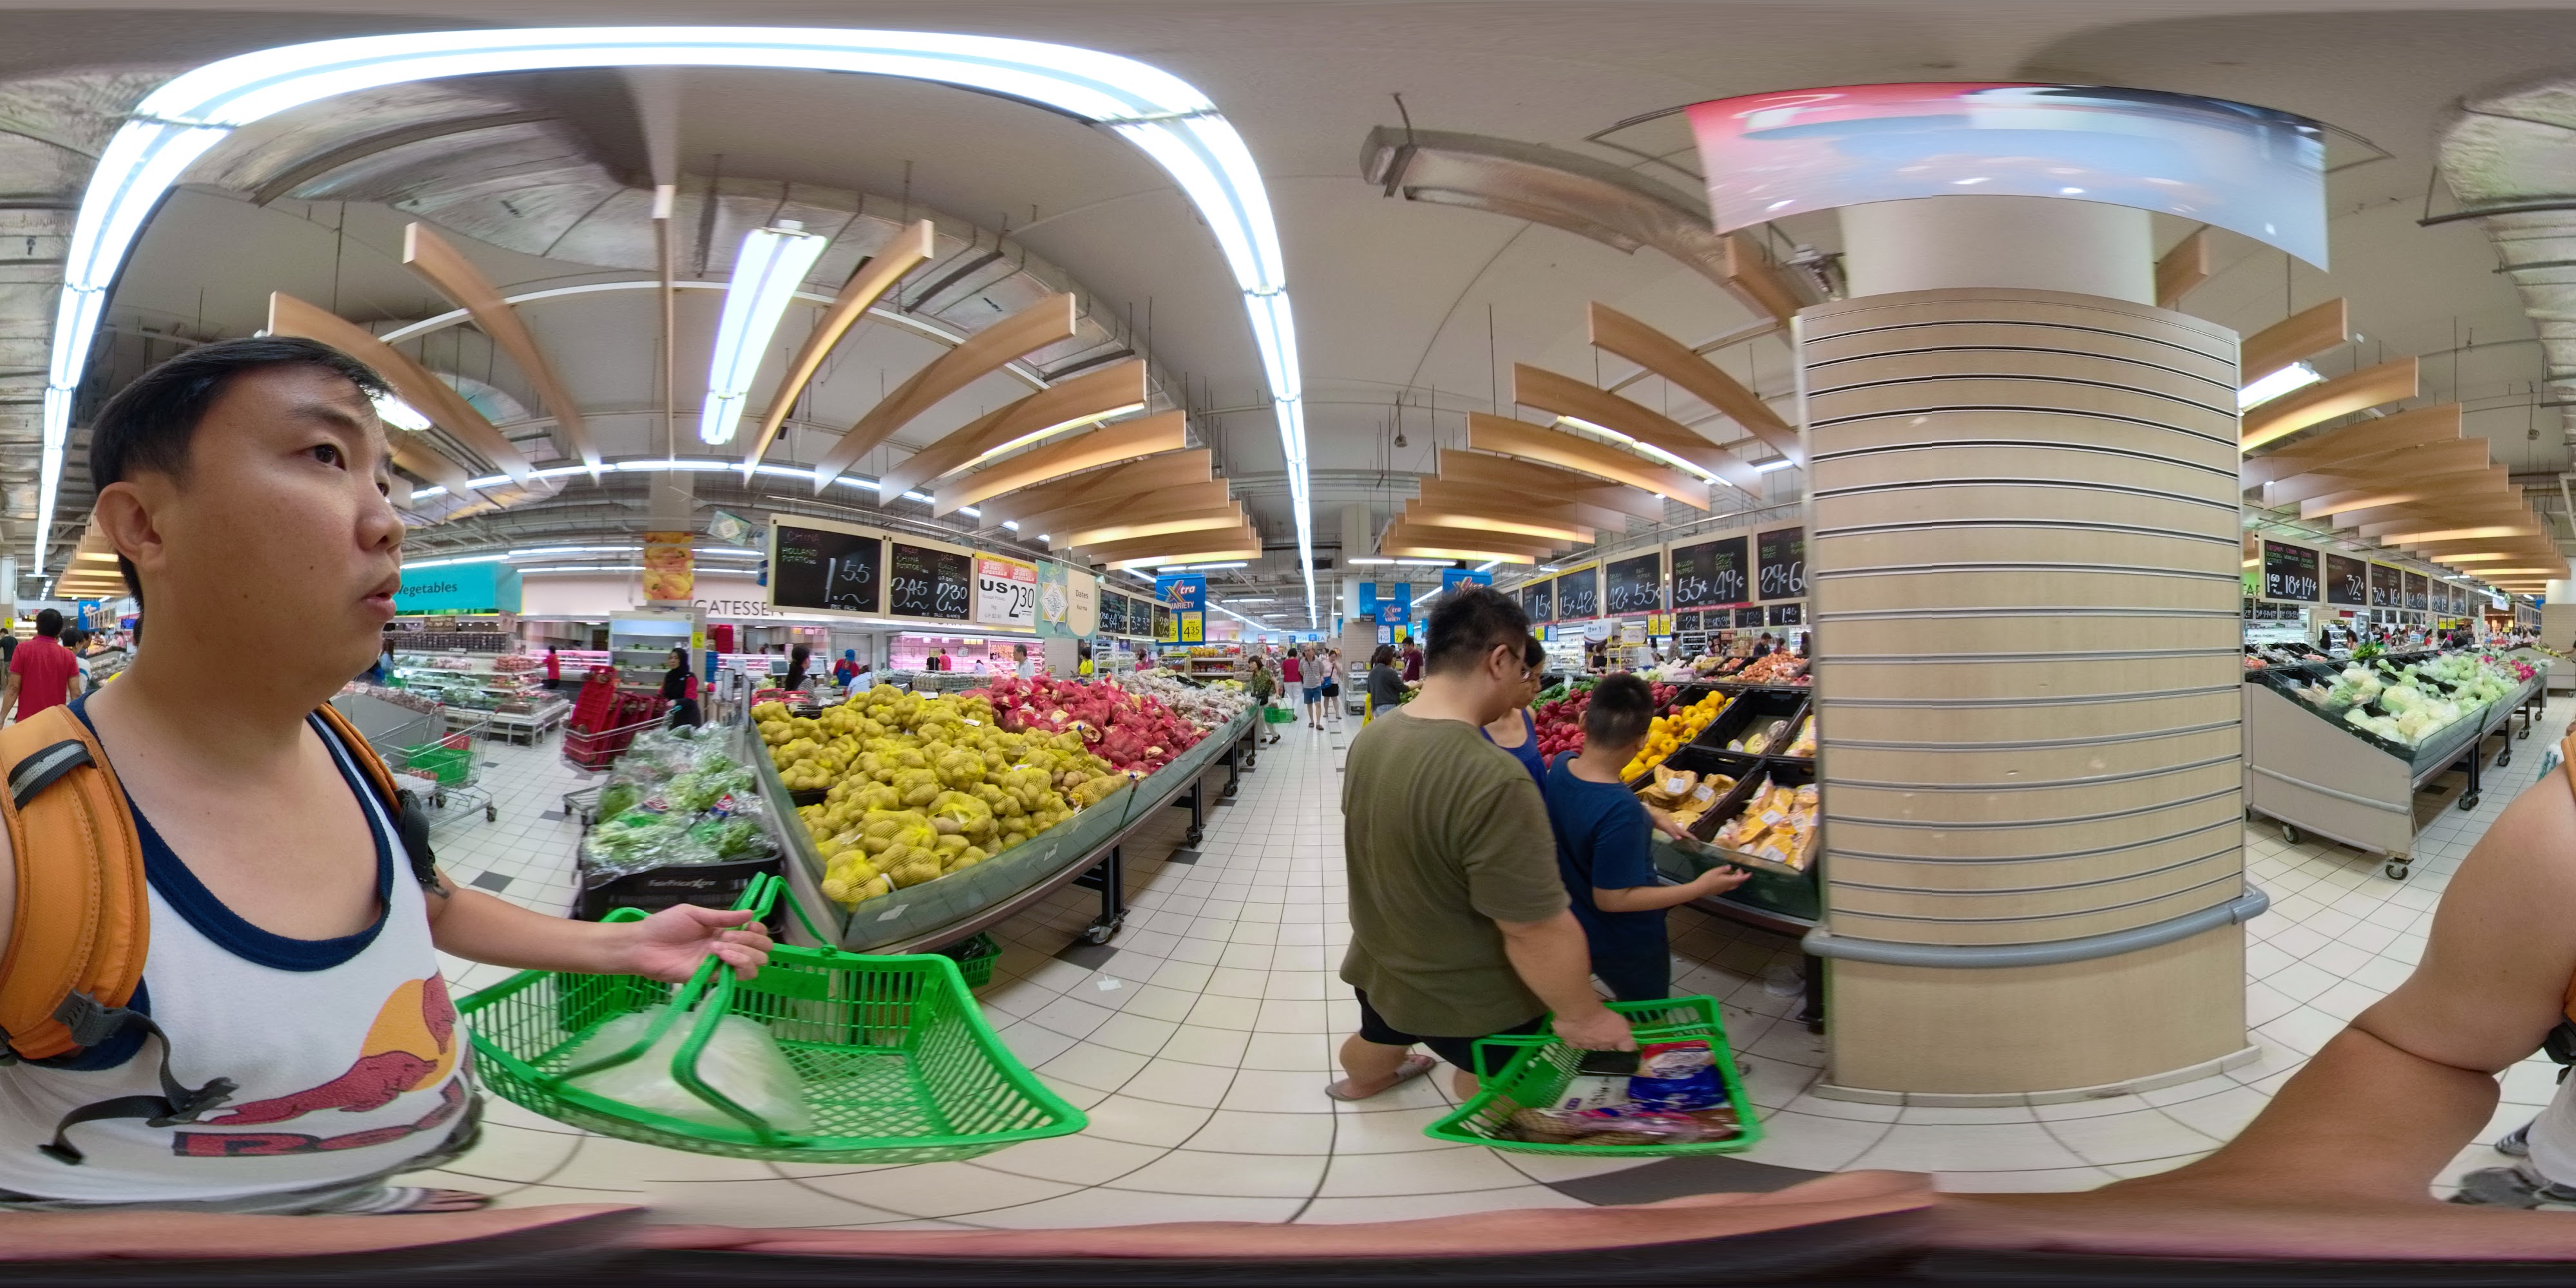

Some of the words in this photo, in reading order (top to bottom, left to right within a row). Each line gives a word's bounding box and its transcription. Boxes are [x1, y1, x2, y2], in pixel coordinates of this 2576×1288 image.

[782, 547, 819, 556] HOLLAND
[896, 554, 920, 564] CHINA
[987, 556, 1014, 565] ADVERTISED
[983, 562, 990, 570] 3
[980, 579, 1008, 594] US
[1164, 580, 1195, 603] Xtra
[1075, 589, 1089, 600] Dates
[1382, 604, 1401, 619] Xtra
